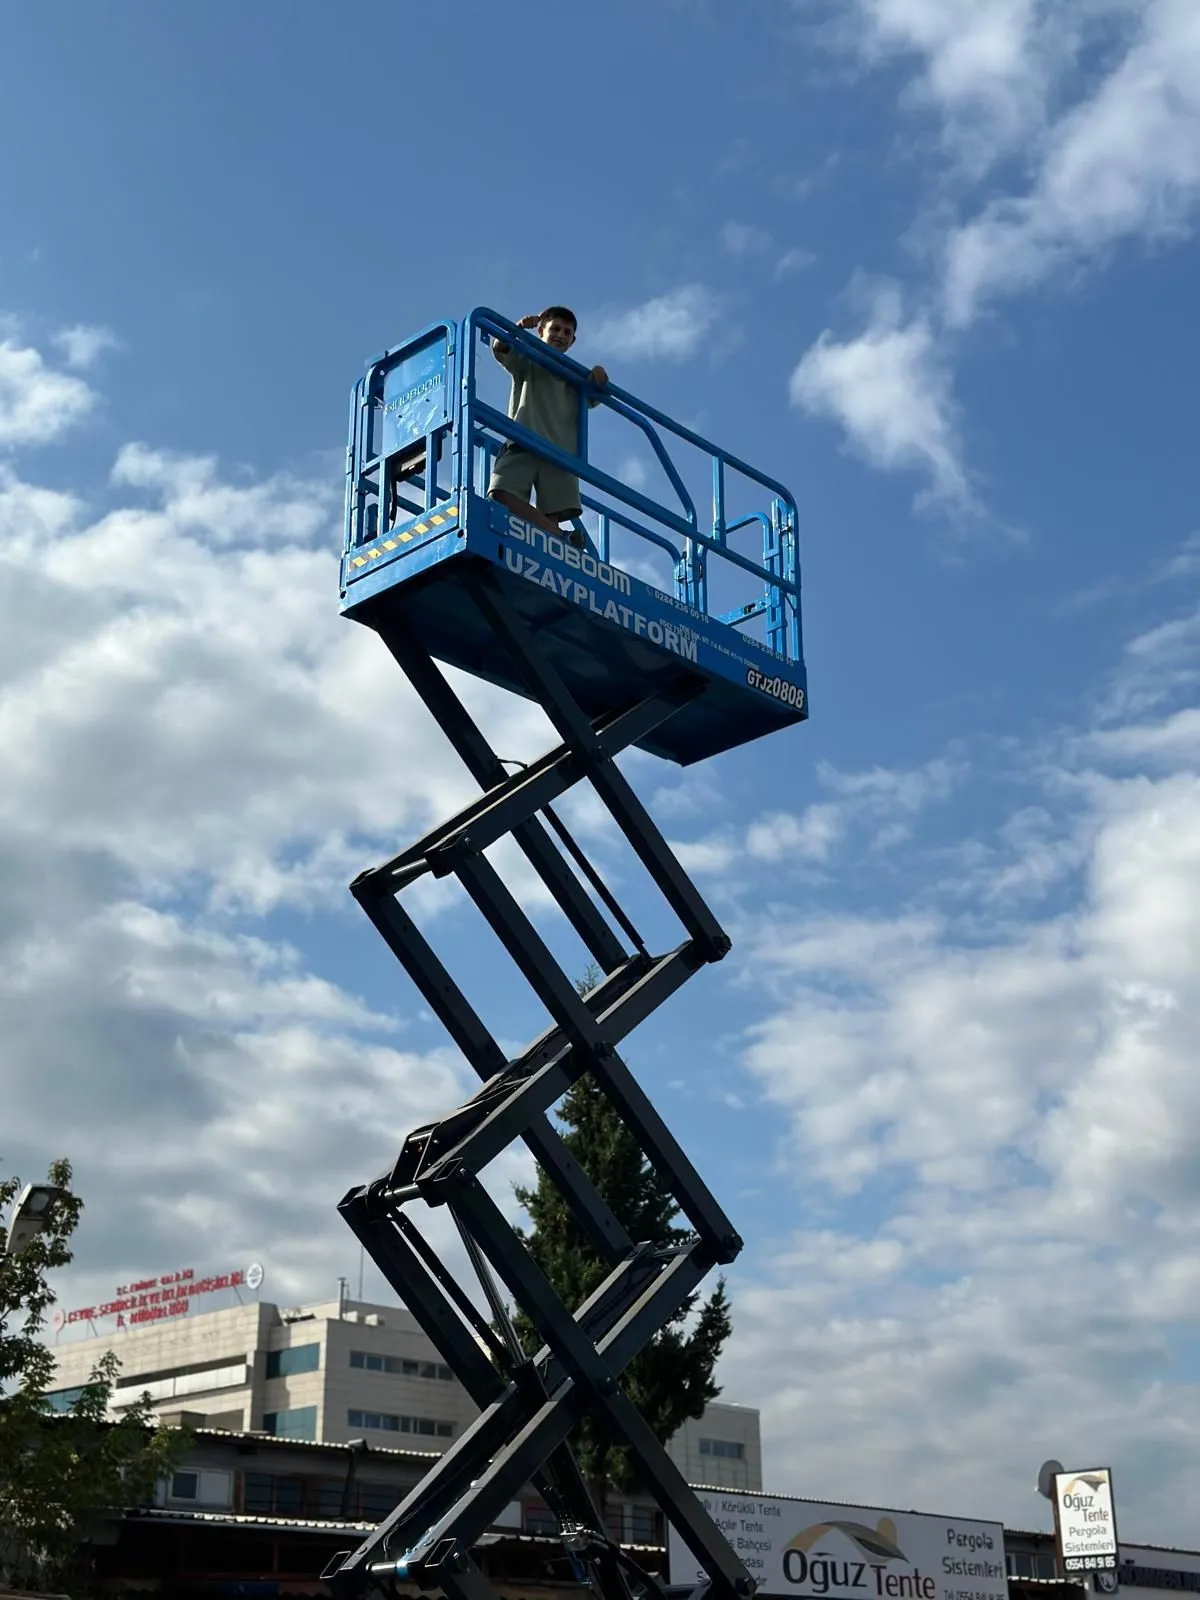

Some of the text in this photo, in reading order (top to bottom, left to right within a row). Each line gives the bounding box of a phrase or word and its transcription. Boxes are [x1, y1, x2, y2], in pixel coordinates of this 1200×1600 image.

[508, 514, 631, 596] SINOBOOM
[1063, 1493, 1094, 1511] Oğuz
[759, 1504, 781, 1517] Tente
[1082, 1508, 1109, 1522] Tente
[741, 1520, 763, 1533] Tente
[1069, 1525, 1107, 1537] Pergola
[737, 1538, 771, 1553] Bahçesi
[946, 1528, 994, 1552] Pergola
[1065, 1540, 1113, 1553] Sistemleri
[782, 1548, 867, 1594] Oğuz
[942, 1556, 1003, 1579] Sistemleri
[1065, 1557, 1084, 1570] 0554
[870, 1564, 935, 1599] Tente
